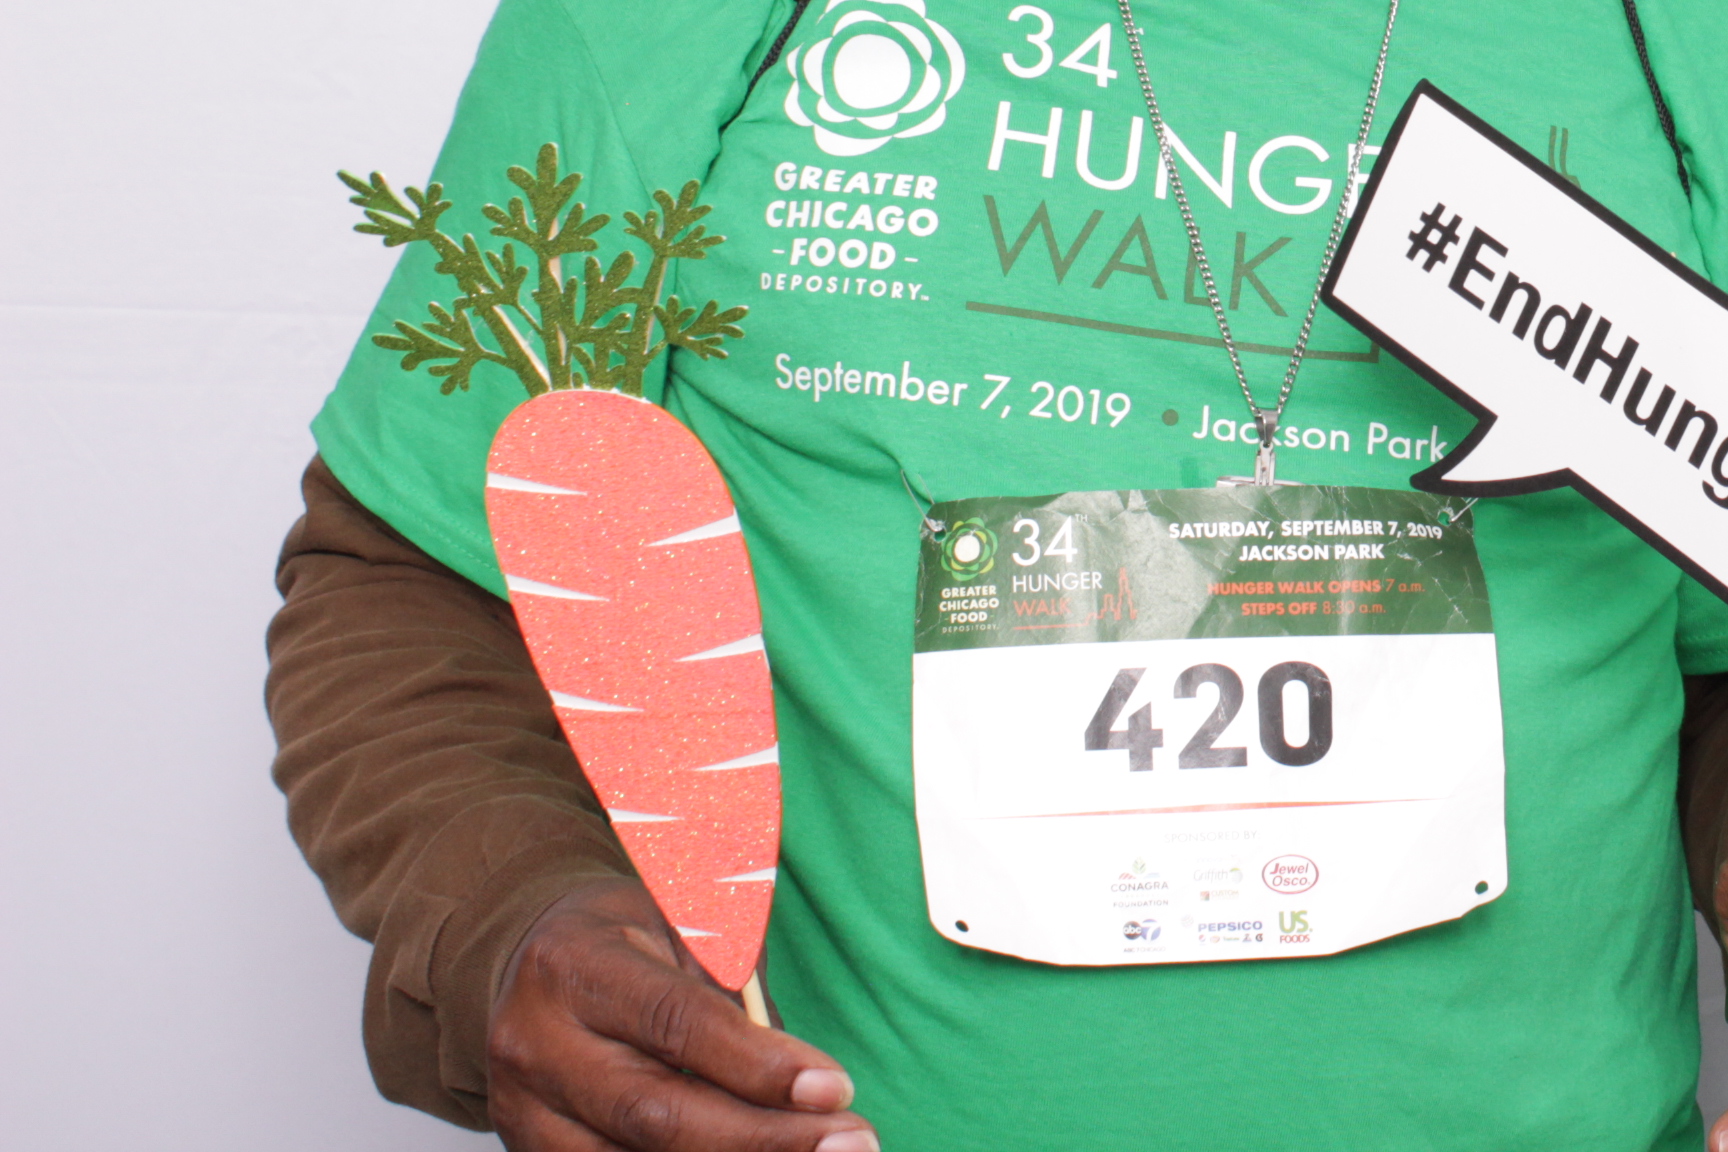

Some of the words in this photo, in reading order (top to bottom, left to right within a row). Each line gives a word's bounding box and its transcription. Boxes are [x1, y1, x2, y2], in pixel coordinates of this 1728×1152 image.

[773, 161, 938, 201] GREATER
[765, 200, 939, 237] CHICAGO
[983, 194, 1293, 318] WALK
[774, 353, 968, 406] September
[981, 374, 1011, 418] 7,
[1028, 380, 1131, 429] 2019
[1169, 521, 1274, 540] SATURDAY,
[1281, 520, 1384, 538] SEPTEMBER
[1387, 521, 1402, 538] 7,
[1407, 522, 1443, 540] 2019
[1239, 545, 1329, 562] JACKSON
[1334, 544, 1385, 560] PARK
[1012, 571, 1103, 593] HUNGER
[1207, 581, 1275, 596] HUNGER
[1277, 580, 1325, 594] WALK
[1328, 579, 1381, 593] OPENS
[1385, 579, 1395, 592] 7
[1399, 581, 1426, 593] a.m.
[941, 585, 997, 599] GREATER
[939, 599, 1000, 612] CHICAGO
[1013, 598, 1073, 617] WALK
[1241, 603, 1284, 616] STEPS
[1288, 602, 1317, 615] OFF
[1322, 601, 1355, 615] 8:30
[1359, 603, 1386, 614] a.m.
[1084, 660, 1333, 772] 420
[1164, 830, 1240, 844] SPONSORED
[1269, 862, 1309, 875] Jewel
[1111, 881, 1169, 892] CONAGRA
[1113, 899, 1169, 908] FOUNDATION
[1123, 924, 1142, 935] abc
[1198, 921, 1263, 933] PEPSICO
[1279, 934, 1310, 944] FOODS
